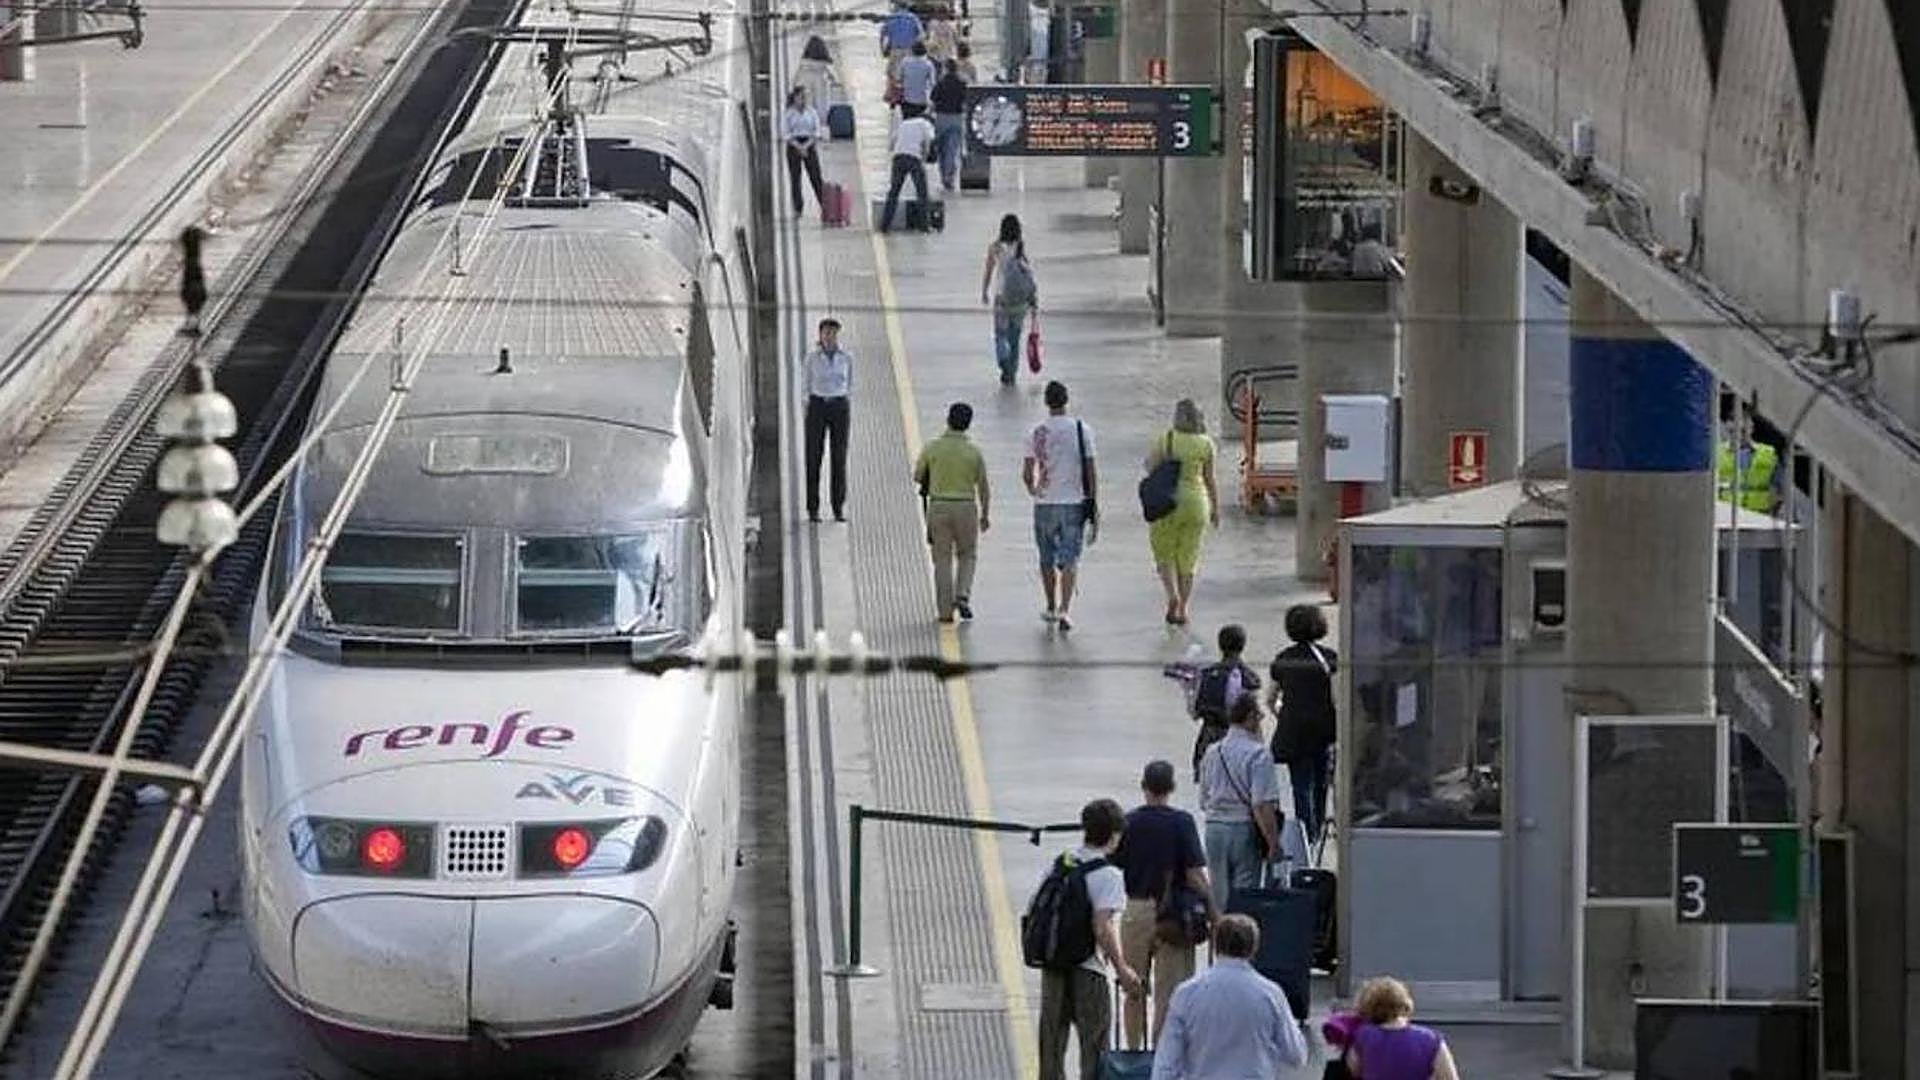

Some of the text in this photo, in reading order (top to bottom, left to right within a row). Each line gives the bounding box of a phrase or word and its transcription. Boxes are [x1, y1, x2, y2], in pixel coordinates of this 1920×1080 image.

[1173, 121, 1190, 149] 3
[344, 709, 575, 758] renfe
[515, 774, 635, 806] AVE
[1681, 874, 1706, 918] 3
